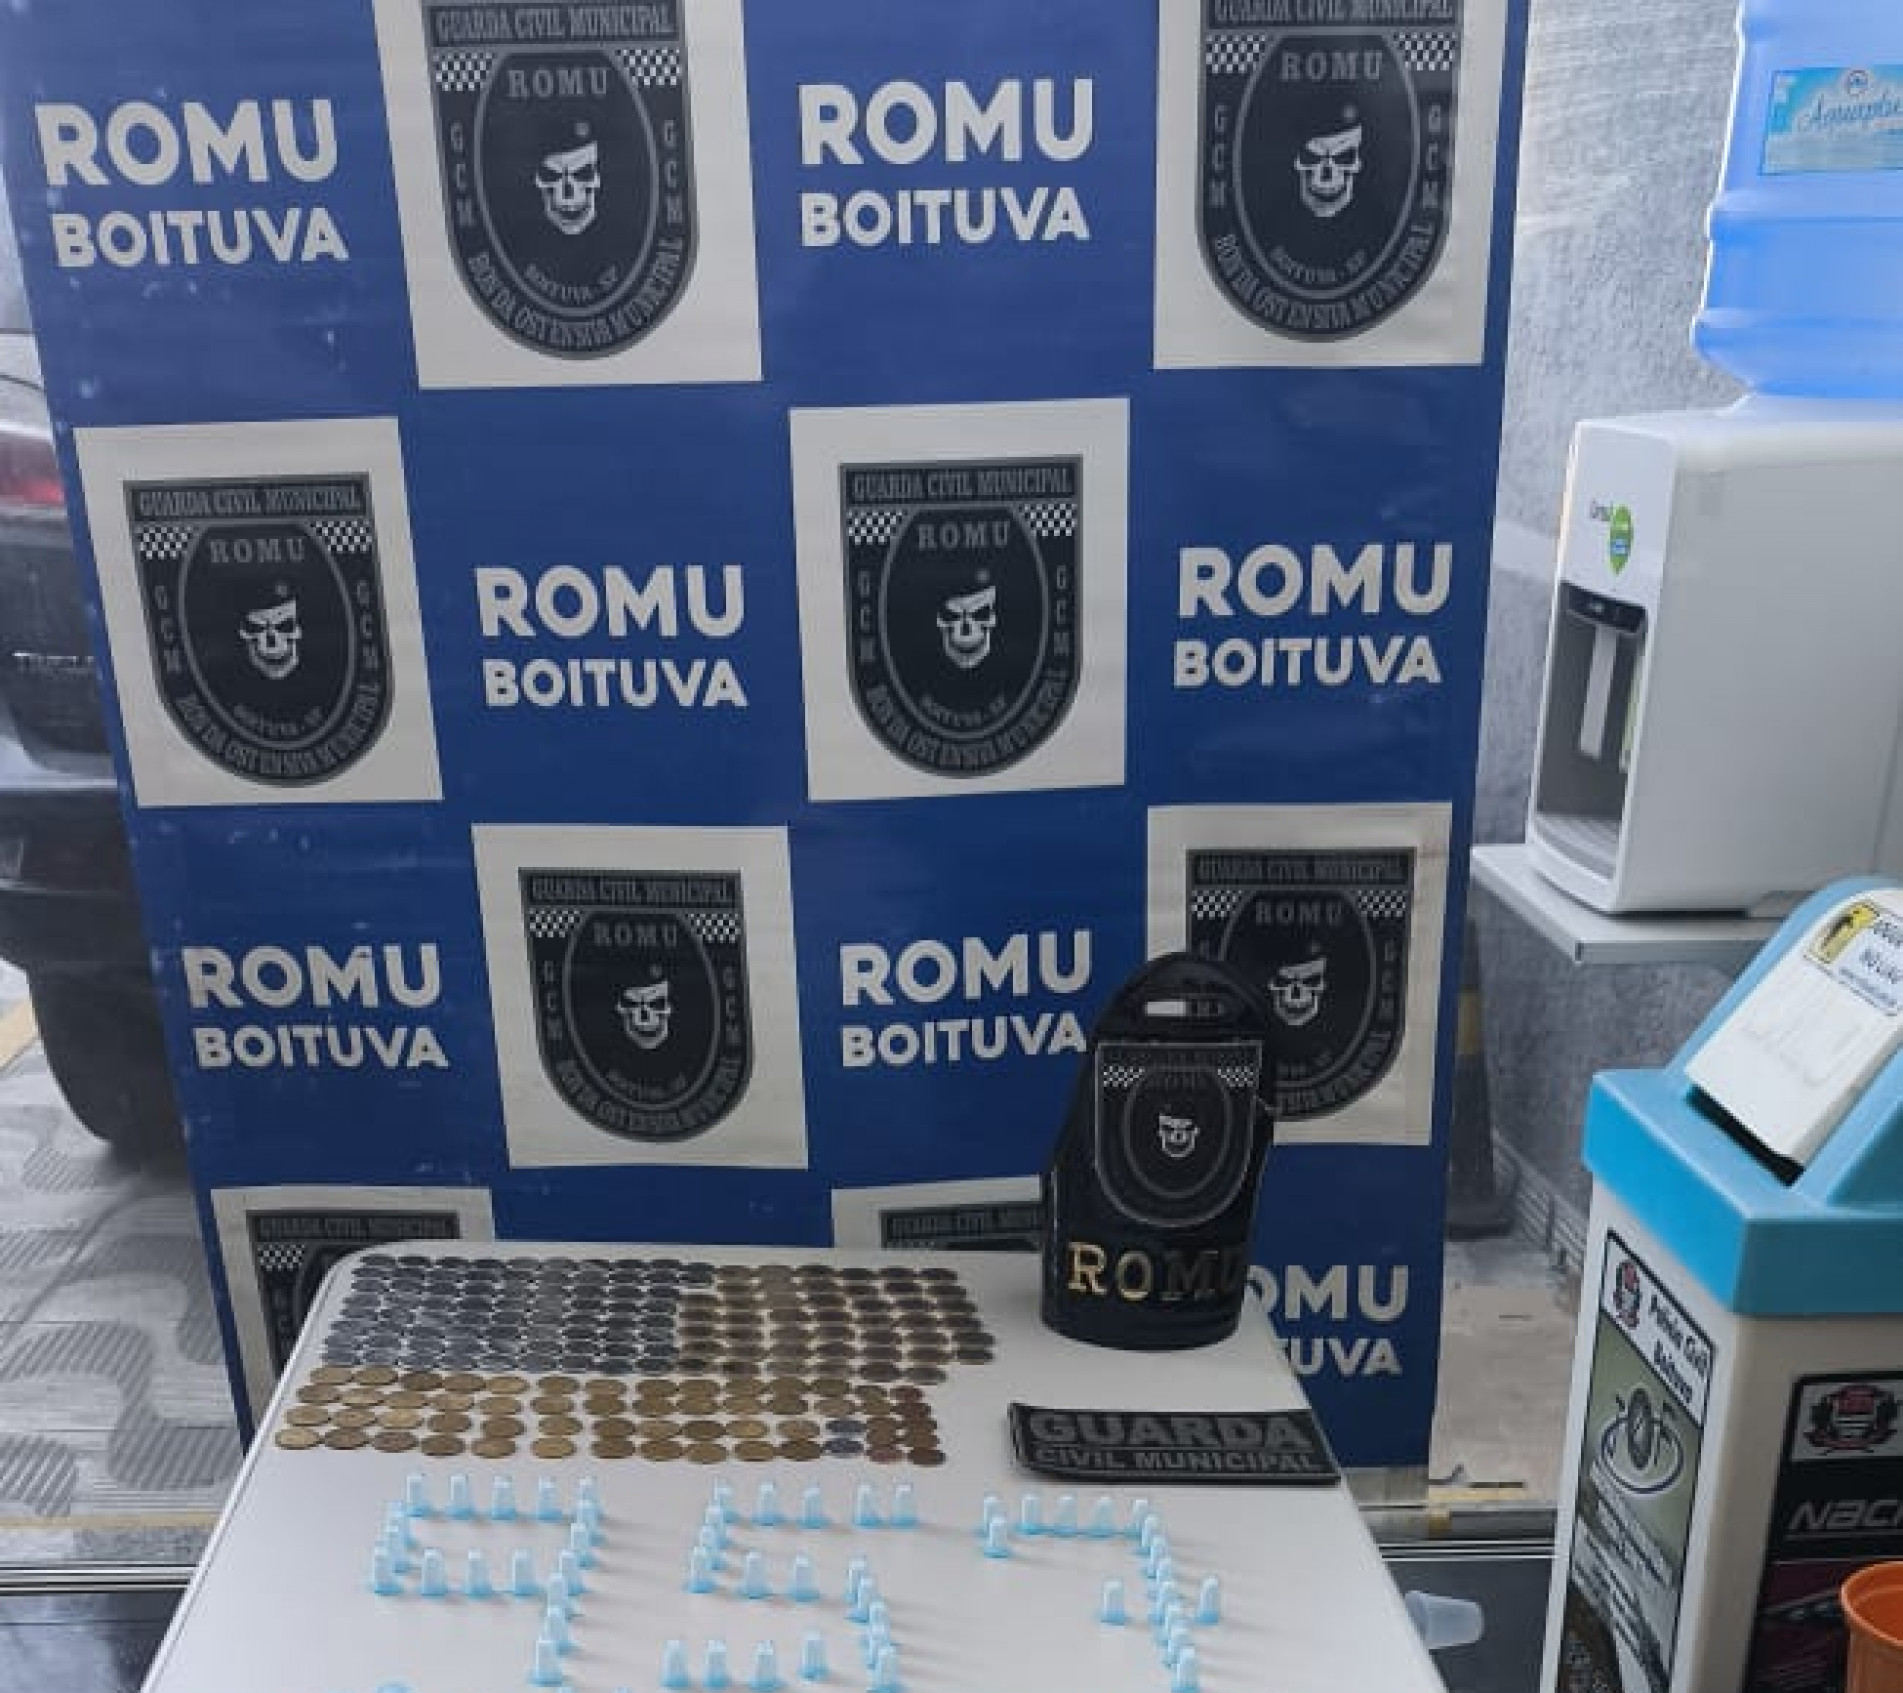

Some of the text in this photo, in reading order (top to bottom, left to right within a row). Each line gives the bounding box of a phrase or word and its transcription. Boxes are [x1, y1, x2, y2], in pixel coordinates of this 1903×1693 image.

[436, 5, 675, 39] GUARDA CIVIL MUNICIPAL
[507, 67, 608, 97] ROMU
[1280, 52, 1383, 82] ROMU
[35, 99, 338, 187] ROMU
[799, 79, 1092, 164] ROMU
[50, 208, 348, 267] BOITUVA
[801, 187, 1090, 246] BOITUVA
[854, 467, 1073, 500] GUARDA CIVIL MUNICIPAL
[210, 538, 307, 563] ROMU
[917, 520, 1010, 549] ROMU
[475, 565, 745, 637] ROMU
[1180, 542, 1453, 618] ROMU
[483, 659, 748, 706] BOITUVA
[1174, 636, 1441, 686] BOITUVA
[594, 921, 679, 946] ROMU
[182, 943, 441, 1008] ROMU
[840, 931, 1090, 1005] ROMU
[193, 1025, 448, 1068] BOITUVA
[843, 1013, 1087, 1067] BOITUVA
[1030, 1411, 1313, 1448] GUARDA
[1036, 1447, 1321, 1473] CIVIL MUNICIPAL
